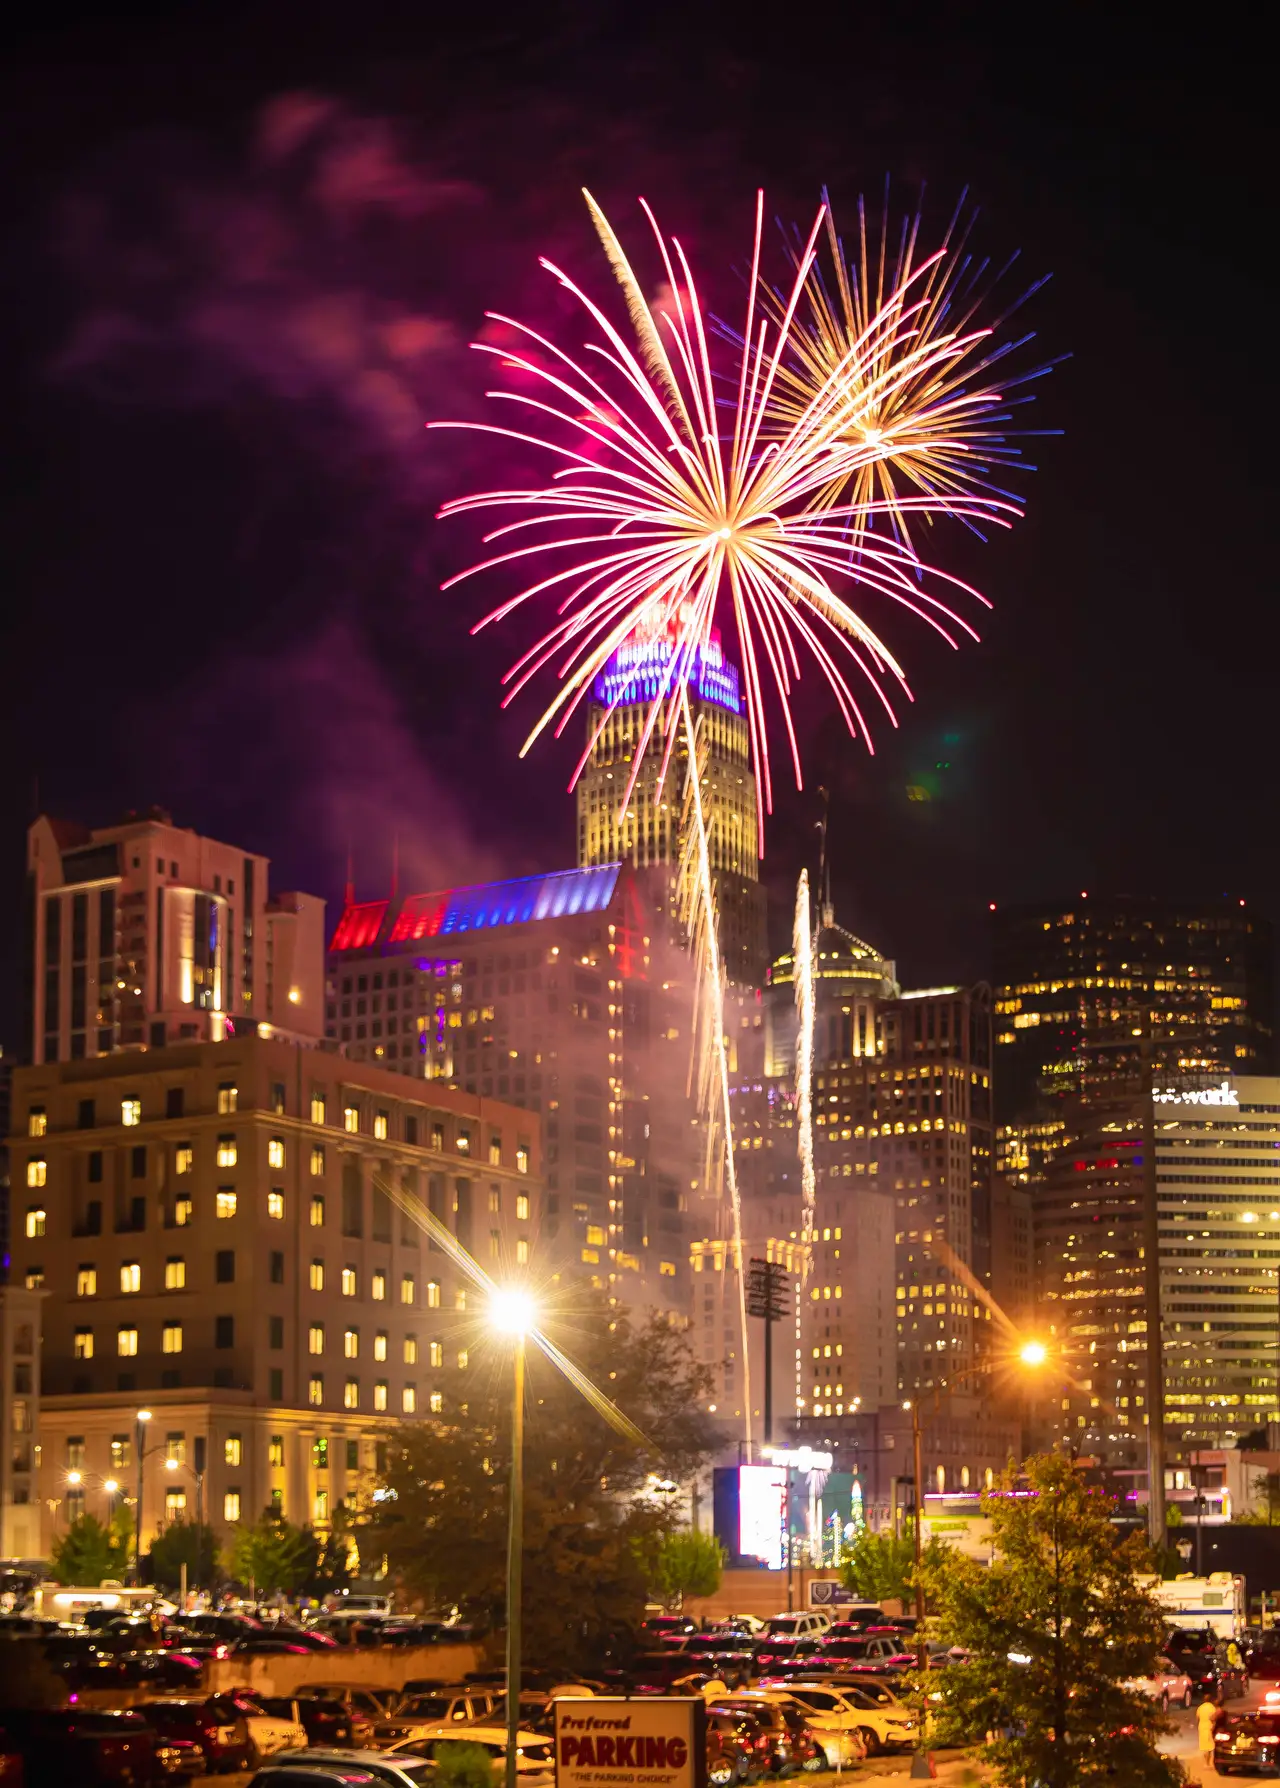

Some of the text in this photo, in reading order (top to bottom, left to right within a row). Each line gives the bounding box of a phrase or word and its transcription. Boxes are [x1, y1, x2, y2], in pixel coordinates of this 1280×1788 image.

[561, 1715, 631, 1731] Preferred
[560, 1735, 688, 1769] PARKING
[594, 1773, 634, 1784] PARKING
